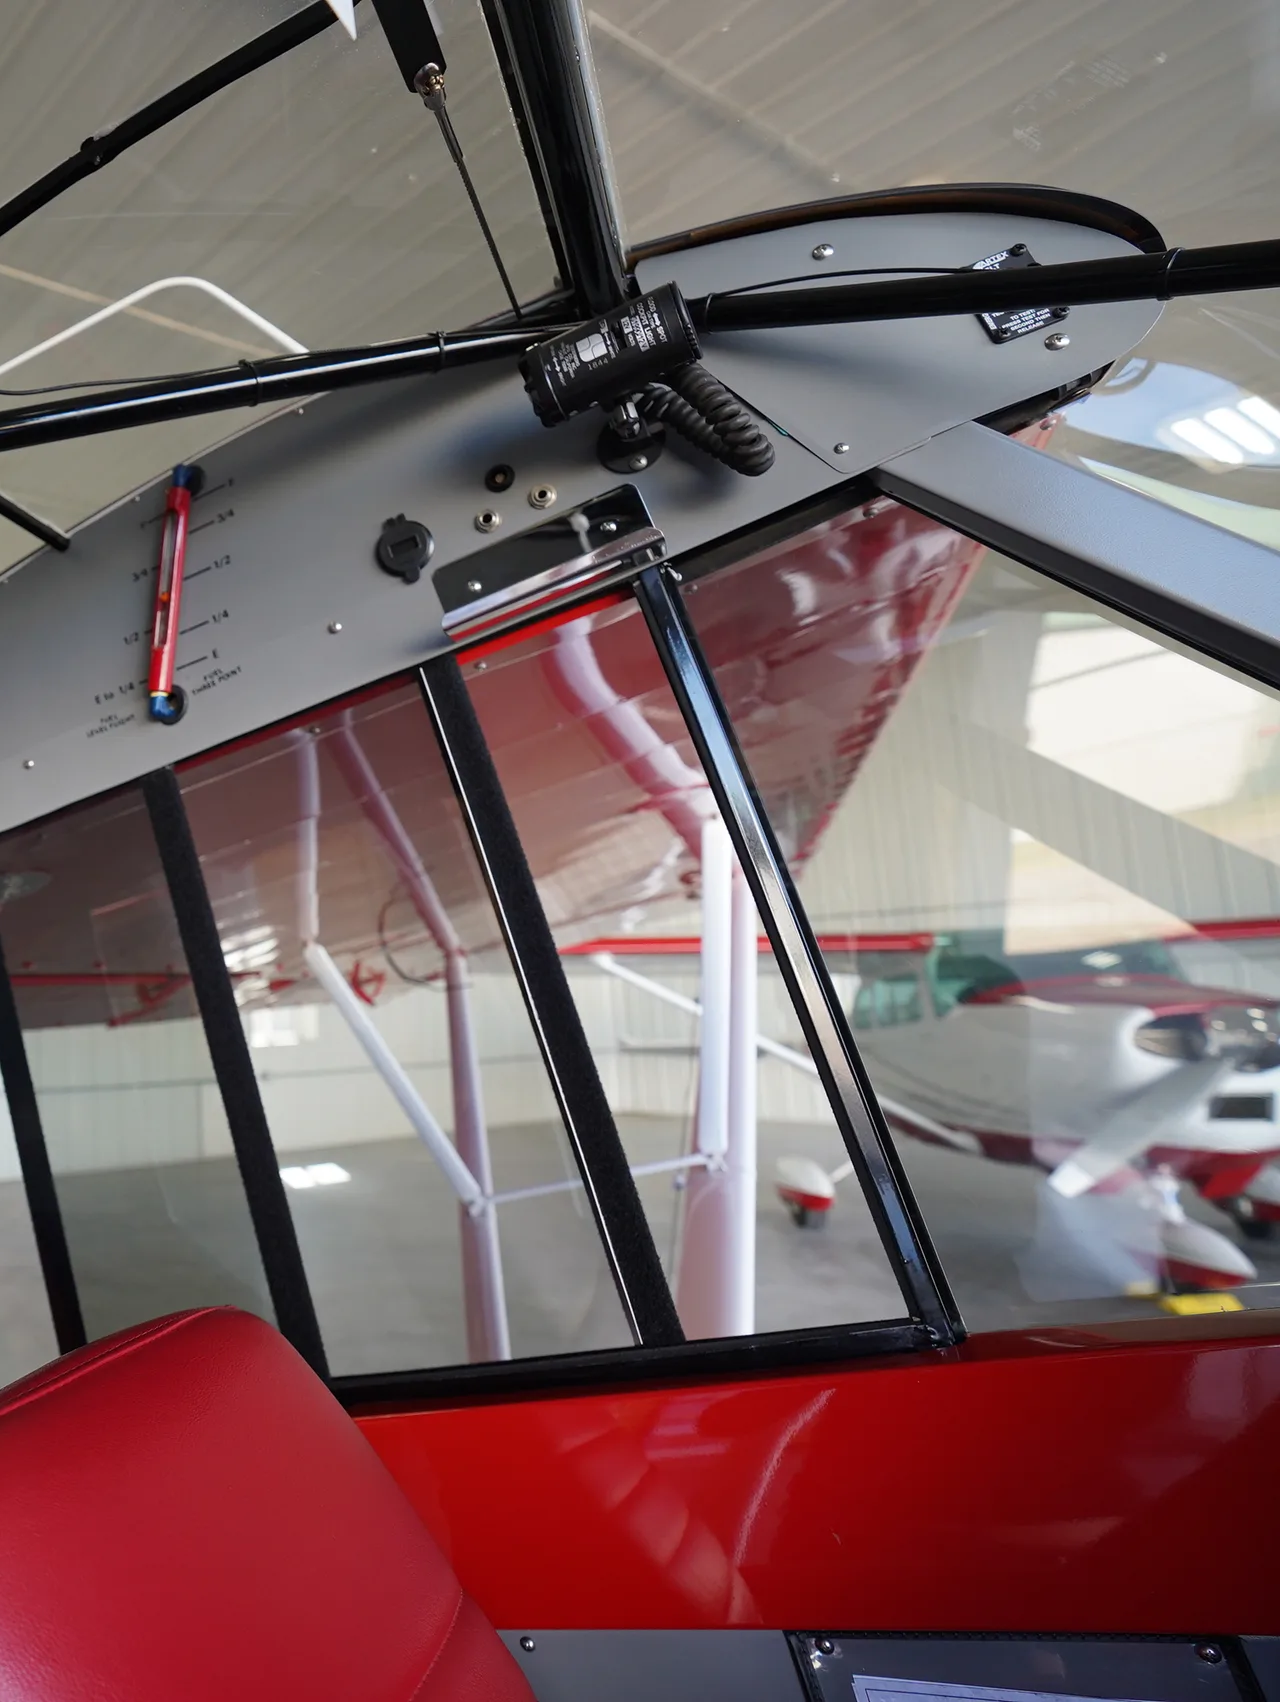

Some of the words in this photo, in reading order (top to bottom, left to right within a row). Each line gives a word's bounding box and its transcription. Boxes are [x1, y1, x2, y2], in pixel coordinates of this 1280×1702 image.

[980, 251, 1009, 267] ARTEX
[637, 302, 649, 326] COCKPIT
[644, 327, 657, 346] LIGHT
[1002, 319, 1022, 329] PRESS
[1021, 314, 1037, 322] TEST
[1037, 308, 1051, 317] FOR
[1010, 319, 1035, 331] SECOND
[1034, 313, 1052, 322] THEN
[657, 326, 668, 343] SPOT
[1017, 321, 1045, 334] RELEASE
[216, 508, 235, 524] 3/4
[213, 554, 232, 569] 1/2
[212, 609, 230, 625] 1/4
[123, 632, 140, 646] 1/2
[211, 649, 220, 659] E
[118, 681, 135, 695] 1/4
